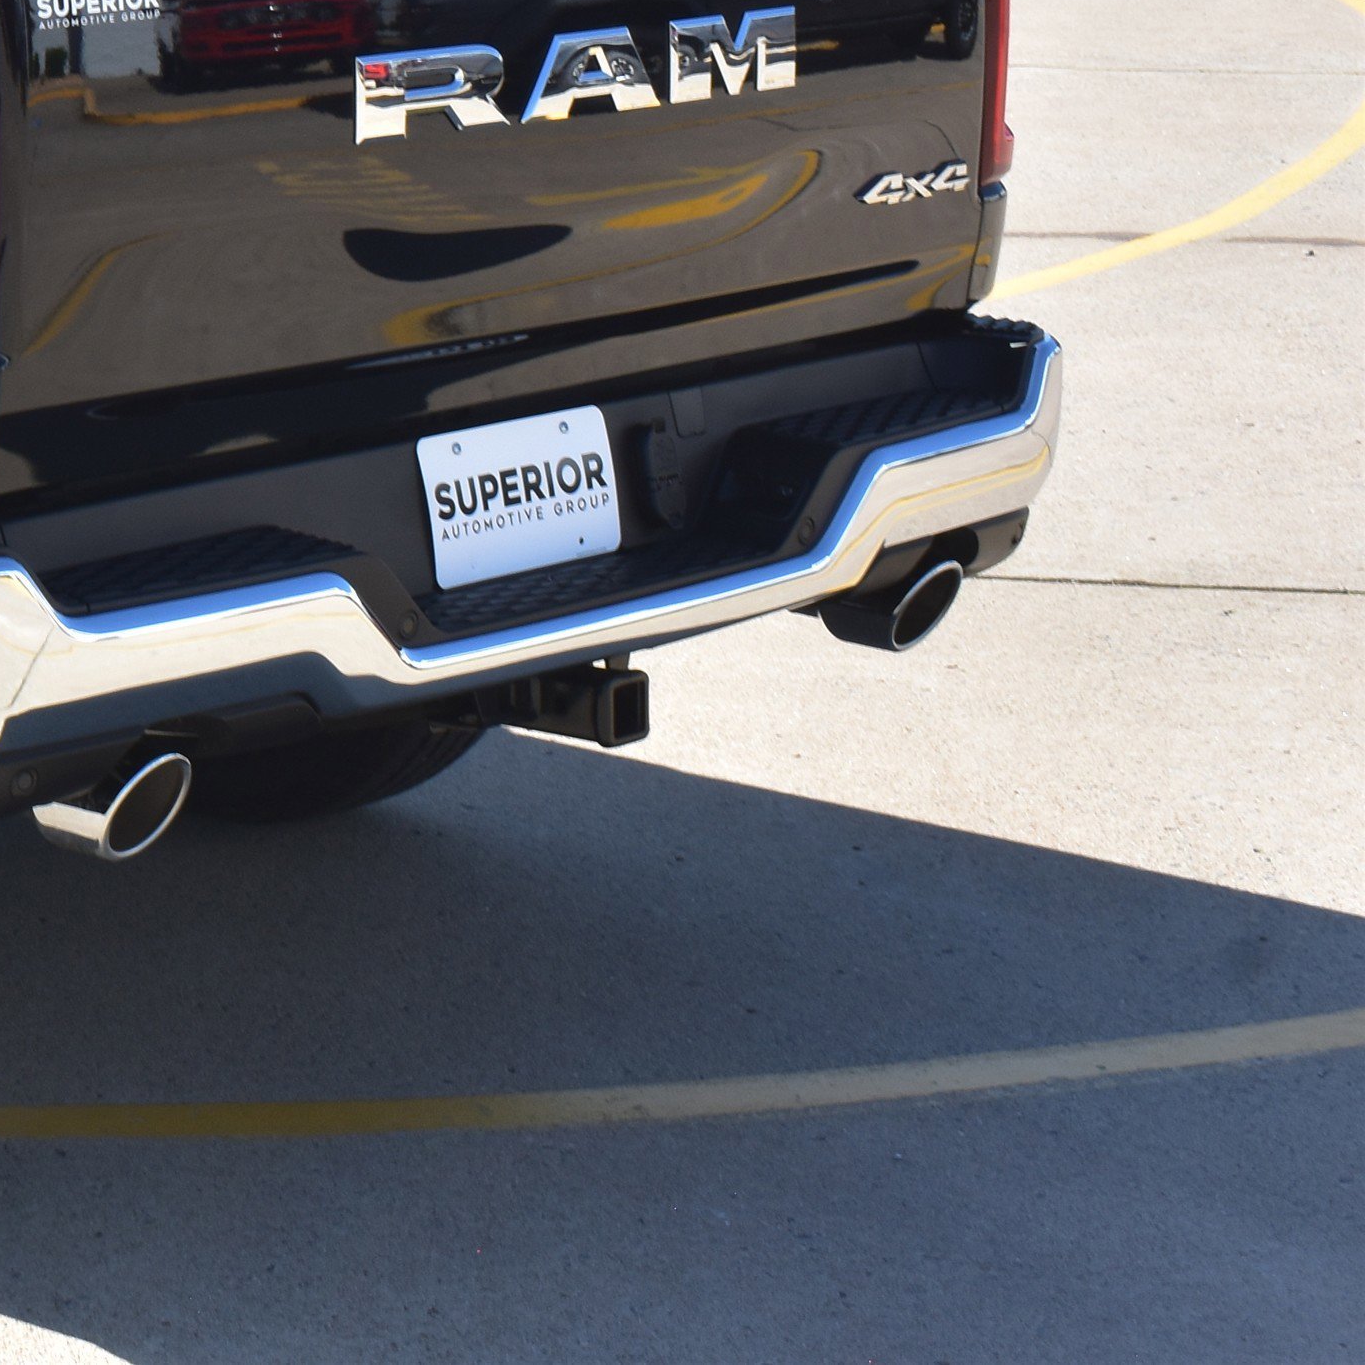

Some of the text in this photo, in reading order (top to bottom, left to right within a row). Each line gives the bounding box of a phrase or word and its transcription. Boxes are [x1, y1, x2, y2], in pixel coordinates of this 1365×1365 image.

[39, 9, 161, 30] AUTOMOTIVE GROUP
[355, 5, 796, 145] RAM
[434, 451, 607, 520] SUPERIOR
[441, 492, 610, 541] AUTOMOTIVE GROUP
